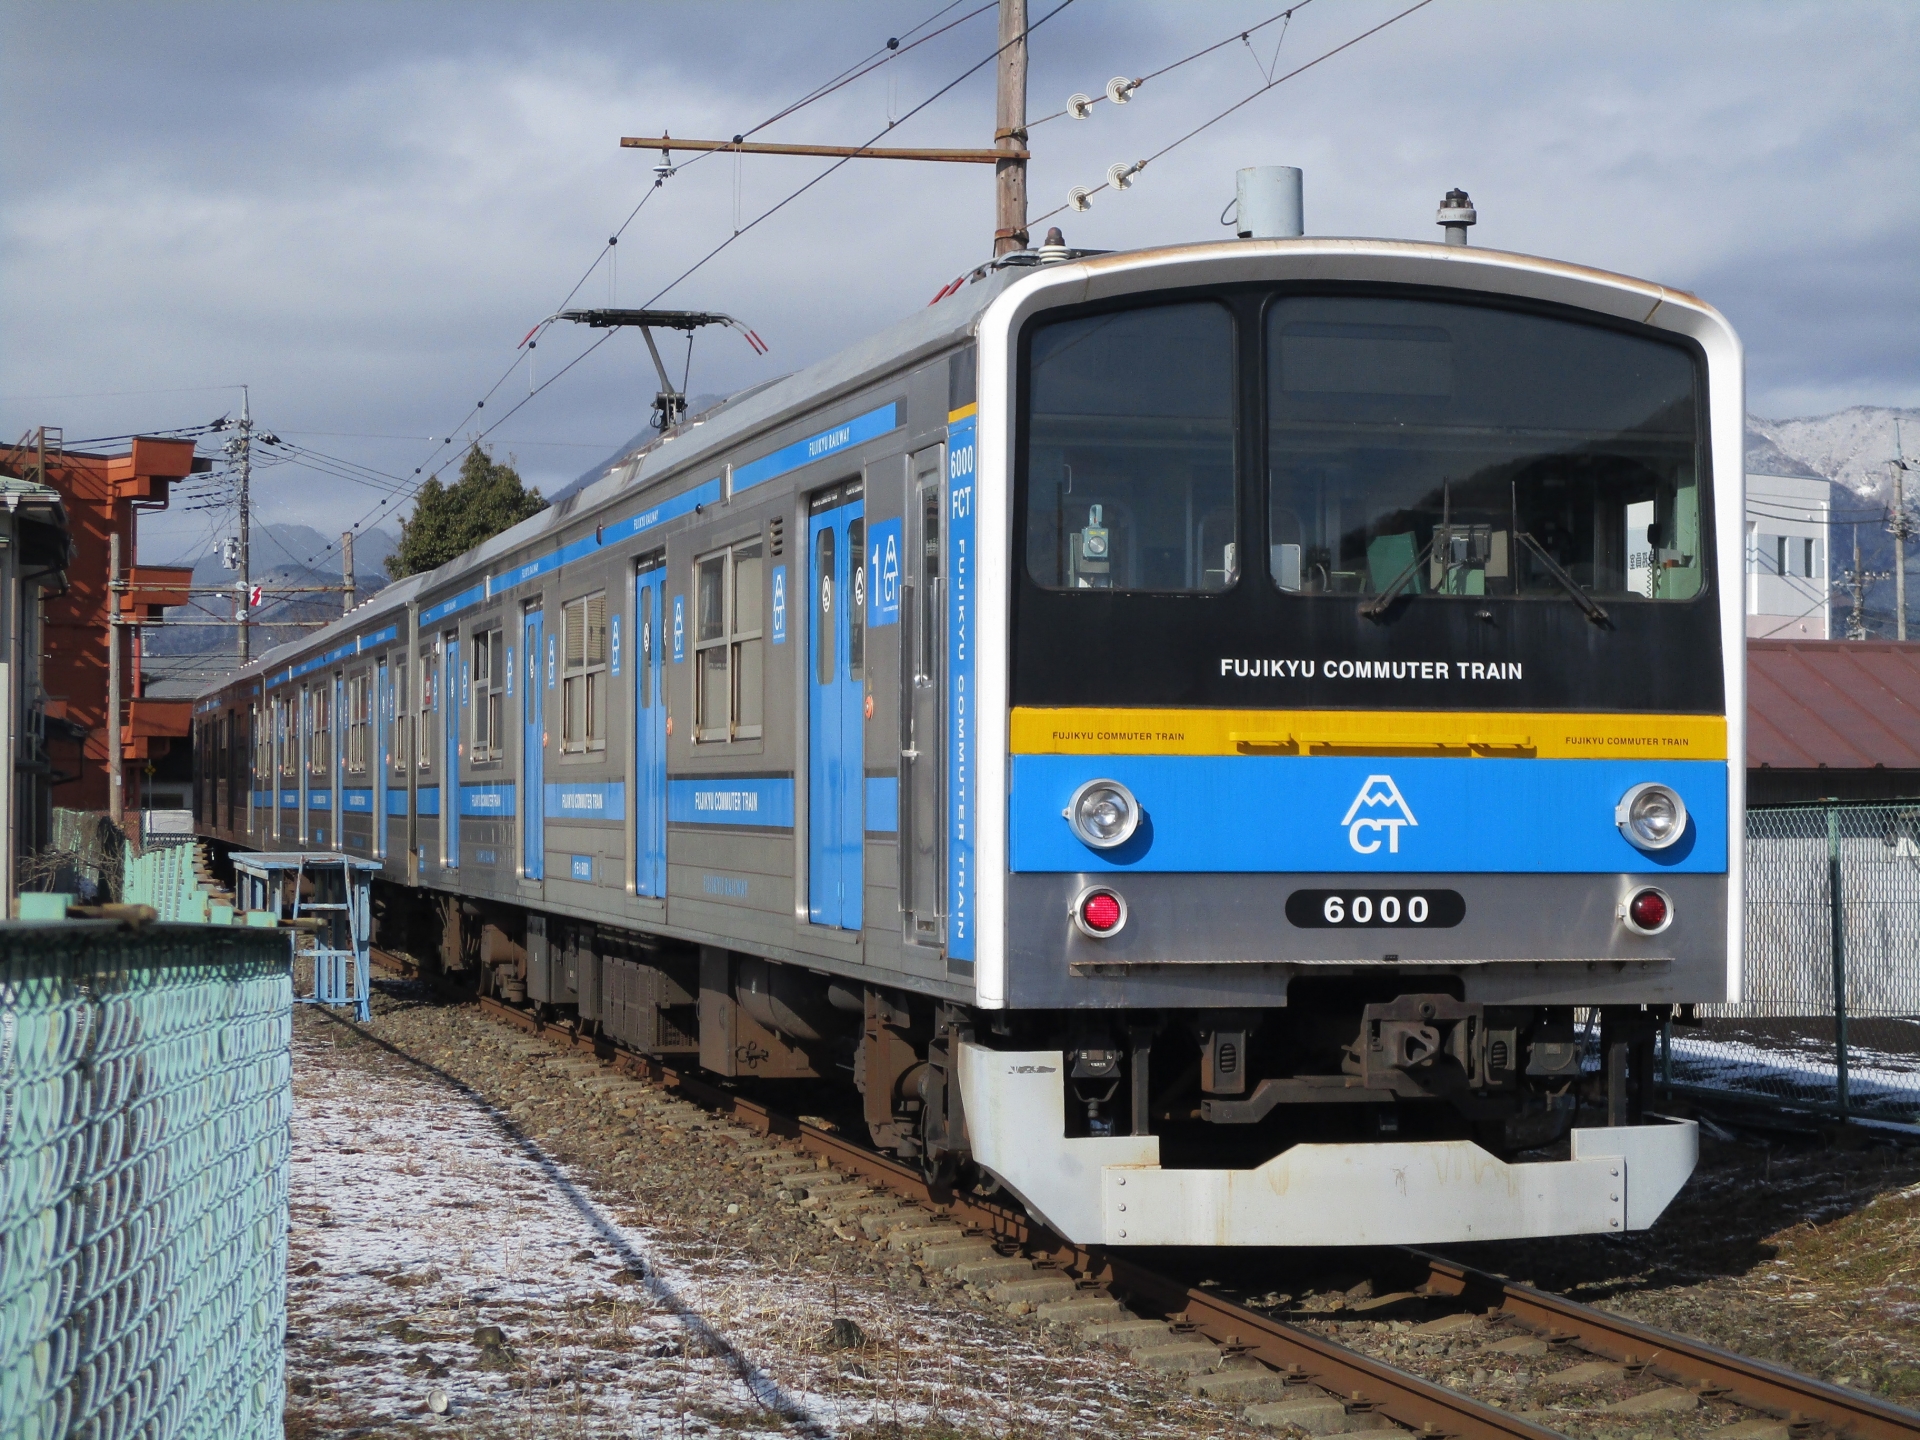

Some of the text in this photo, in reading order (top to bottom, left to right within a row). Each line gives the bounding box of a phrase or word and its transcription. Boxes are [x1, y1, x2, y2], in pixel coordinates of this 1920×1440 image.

[829, 427, 850, 449] RAILWAY
[951, 445, 973, 479] 6000
[952, 486, 971, 520] FCT
[872, 543, 879, 607] 1
[1221, 658, 1522, 680] FUJIKYU COMMUTER TRAIN
[1052, 731, 1185, 741] FUJIKYU COMMUTER TRAIN
[1565, 736, 1689, 746] FUJIKYU COMMUTER TRAIN
[695, 792, 758, 811] FUJIKYU COMMUTER TRAIN
[957, 852, 965, 939] TRAIN
[1324, 896, 1429, 923] 6000
